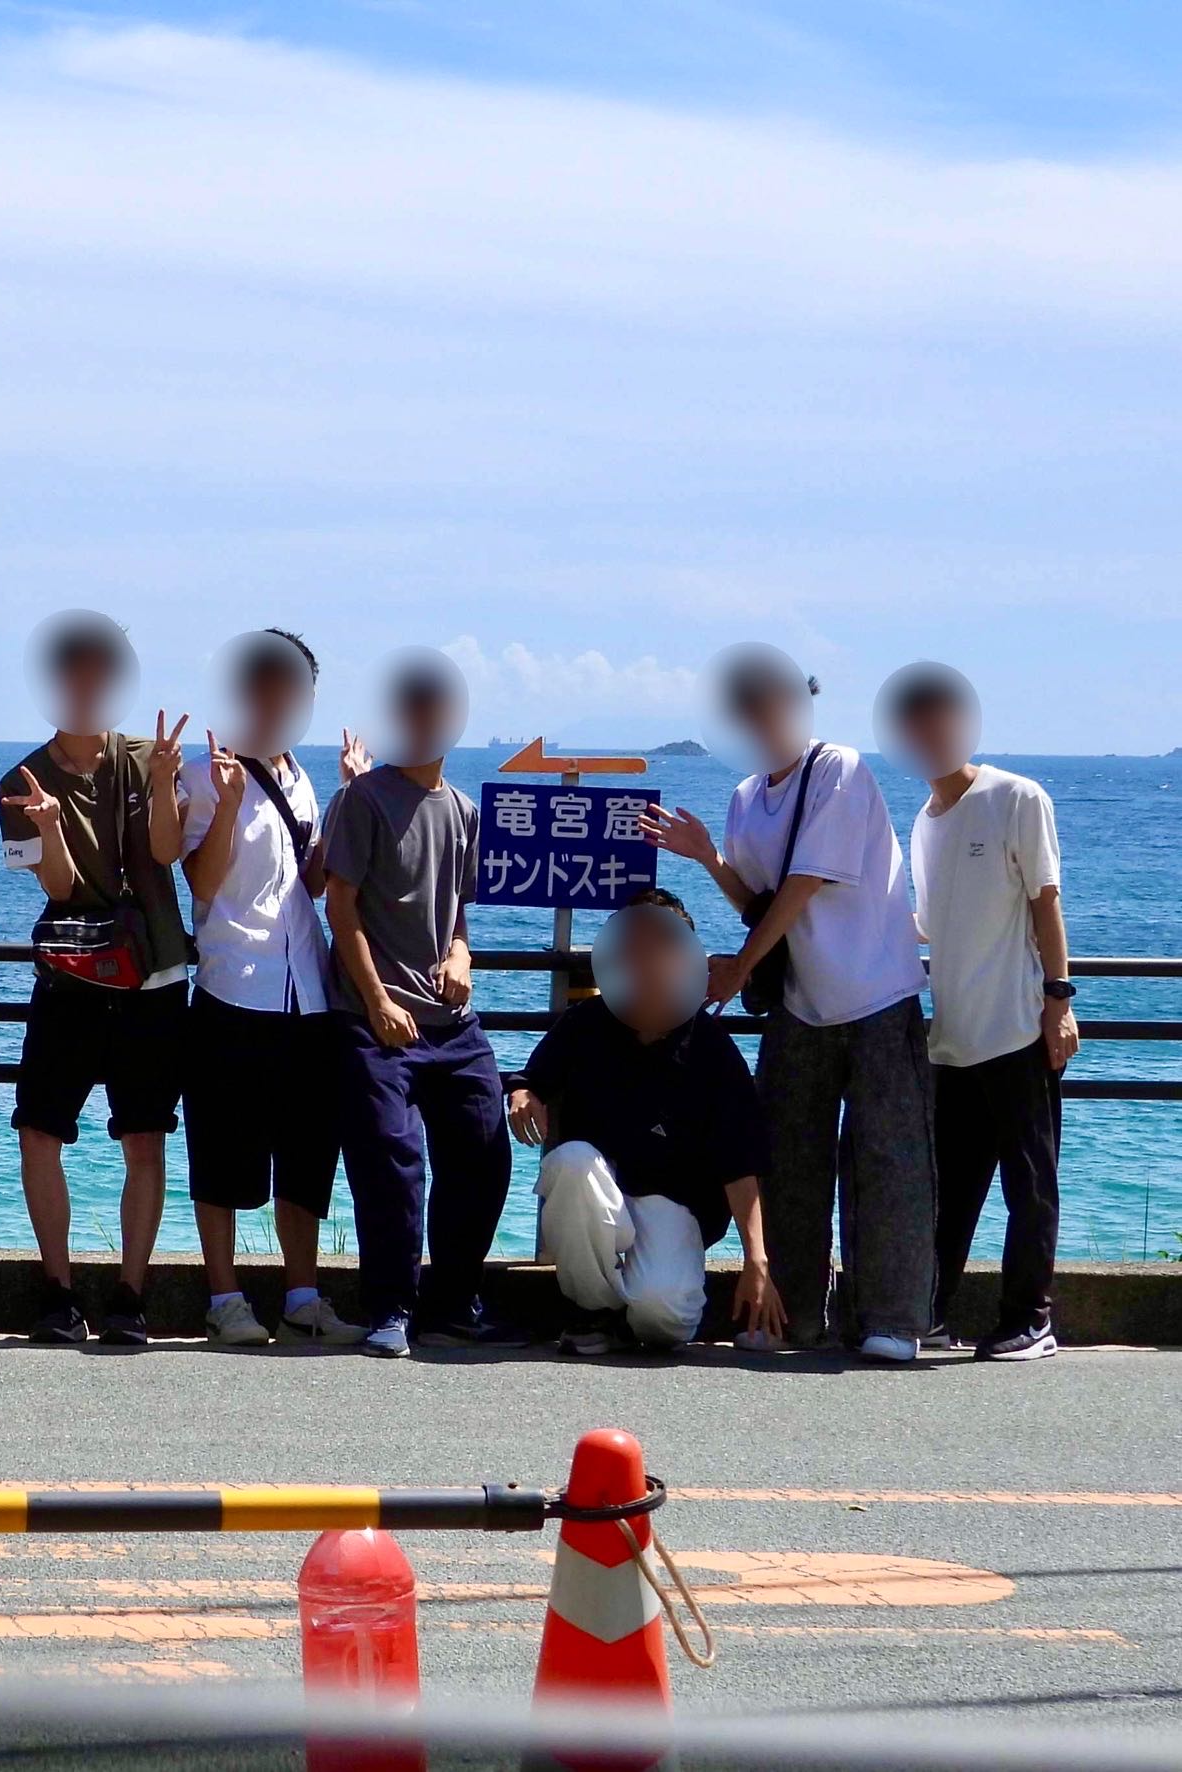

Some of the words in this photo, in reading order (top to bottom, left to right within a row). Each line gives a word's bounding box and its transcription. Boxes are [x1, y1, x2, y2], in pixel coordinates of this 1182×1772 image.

[493, 790, 648, 841] 竜宮窟
[483, 850, 651, 899] サンドスキー
